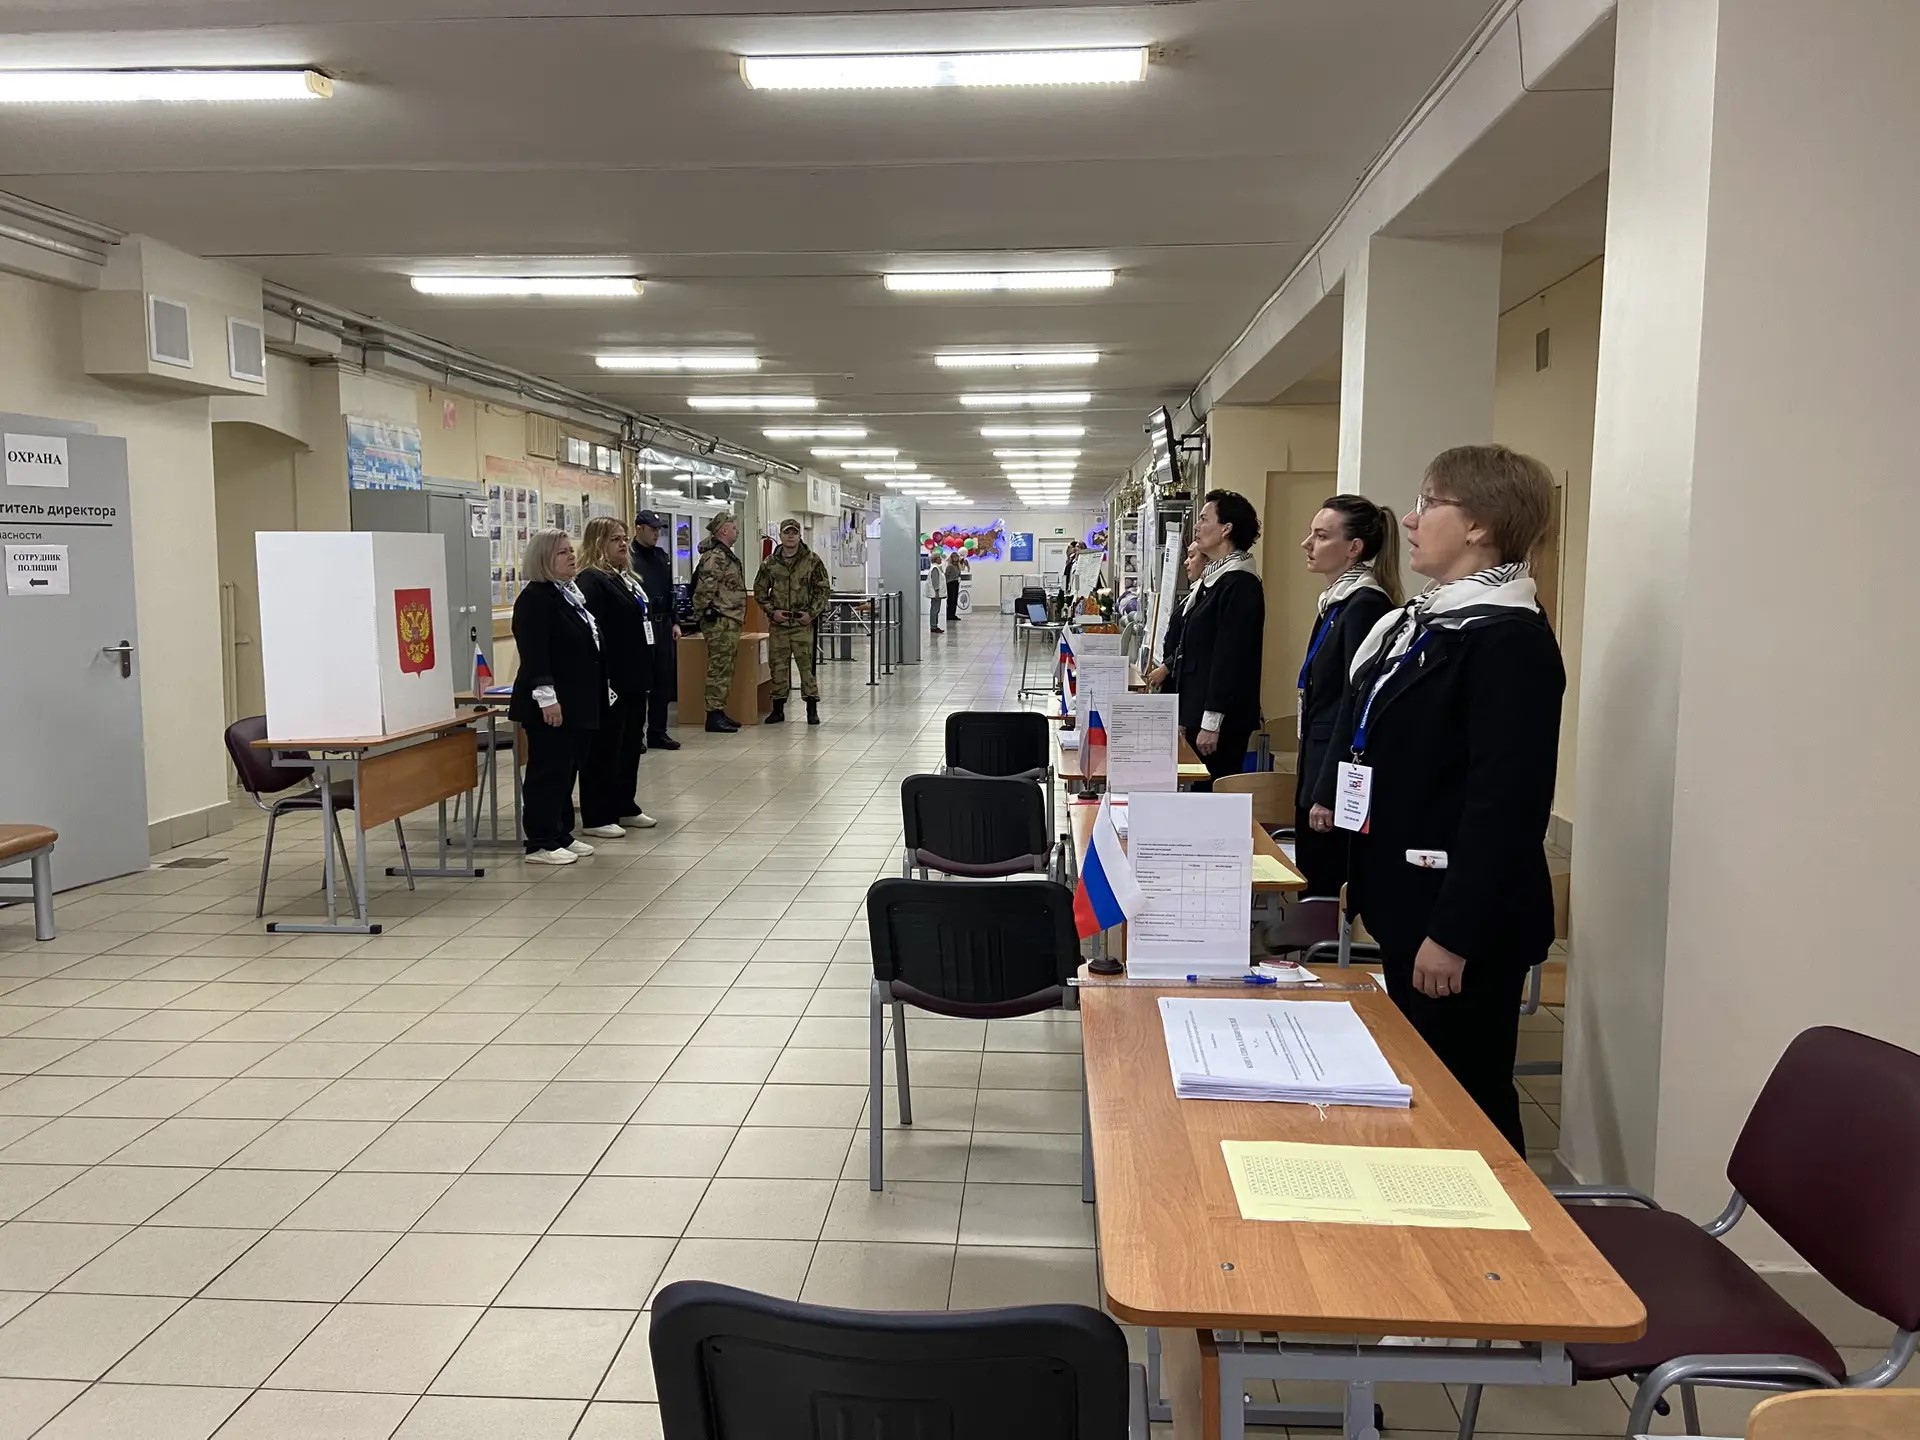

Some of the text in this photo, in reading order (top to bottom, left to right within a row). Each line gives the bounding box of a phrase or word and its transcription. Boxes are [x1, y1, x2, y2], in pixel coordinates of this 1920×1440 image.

[8, 450, 62, 465] ОХРАНА
[47, 505, 116, 519] директора
[0, 532, 42, 540] асности
[13, 553, 61, 562] СОТРУДНИК
[17, 564, 58, 572] ПОЛИЦИИ
